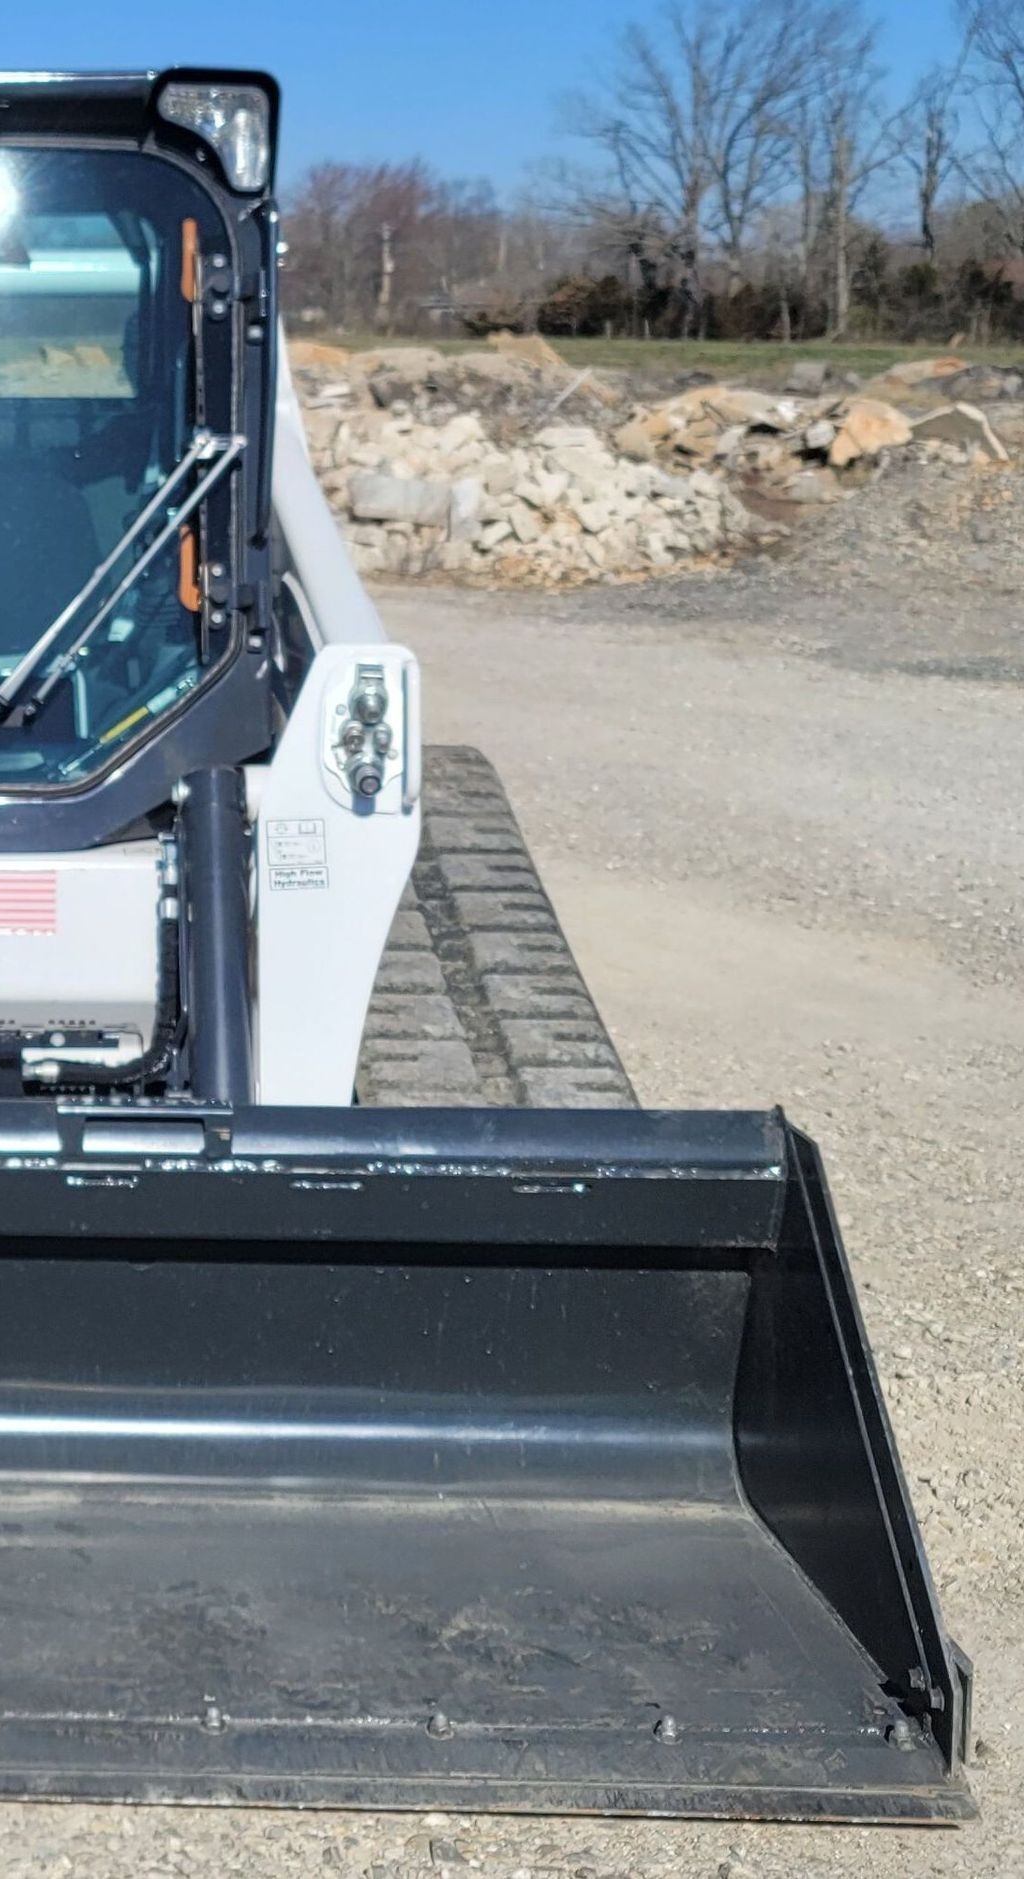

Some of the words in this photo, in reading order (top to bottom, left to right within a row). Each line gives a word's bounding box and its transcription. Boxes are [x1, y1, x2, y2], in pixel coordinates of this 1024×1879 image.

[274, 870, 297, 879] High
[299, 869, 323, 877] Flow
[273, 878, 326, 889] Hydraulics
